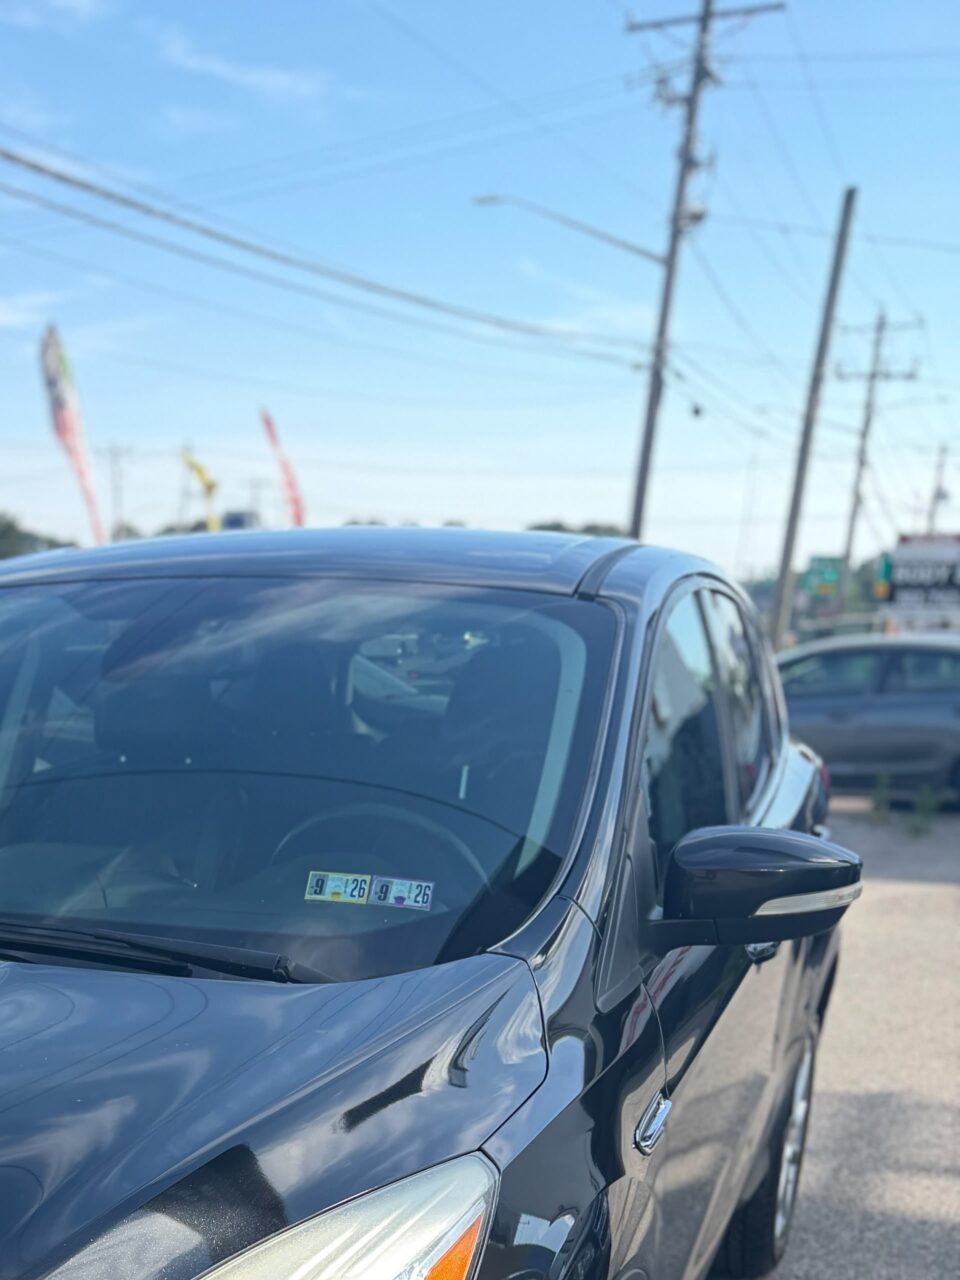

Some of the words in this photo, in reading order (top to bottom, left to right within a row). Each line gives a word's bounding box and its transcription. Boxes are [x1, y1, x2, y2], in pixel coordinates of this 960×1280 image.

[313, 878, 325, 895] 9
[350, 878, 367, 898] 26
[378, 884, 389, 901] 9
[414, 884, 431, 904] 26
